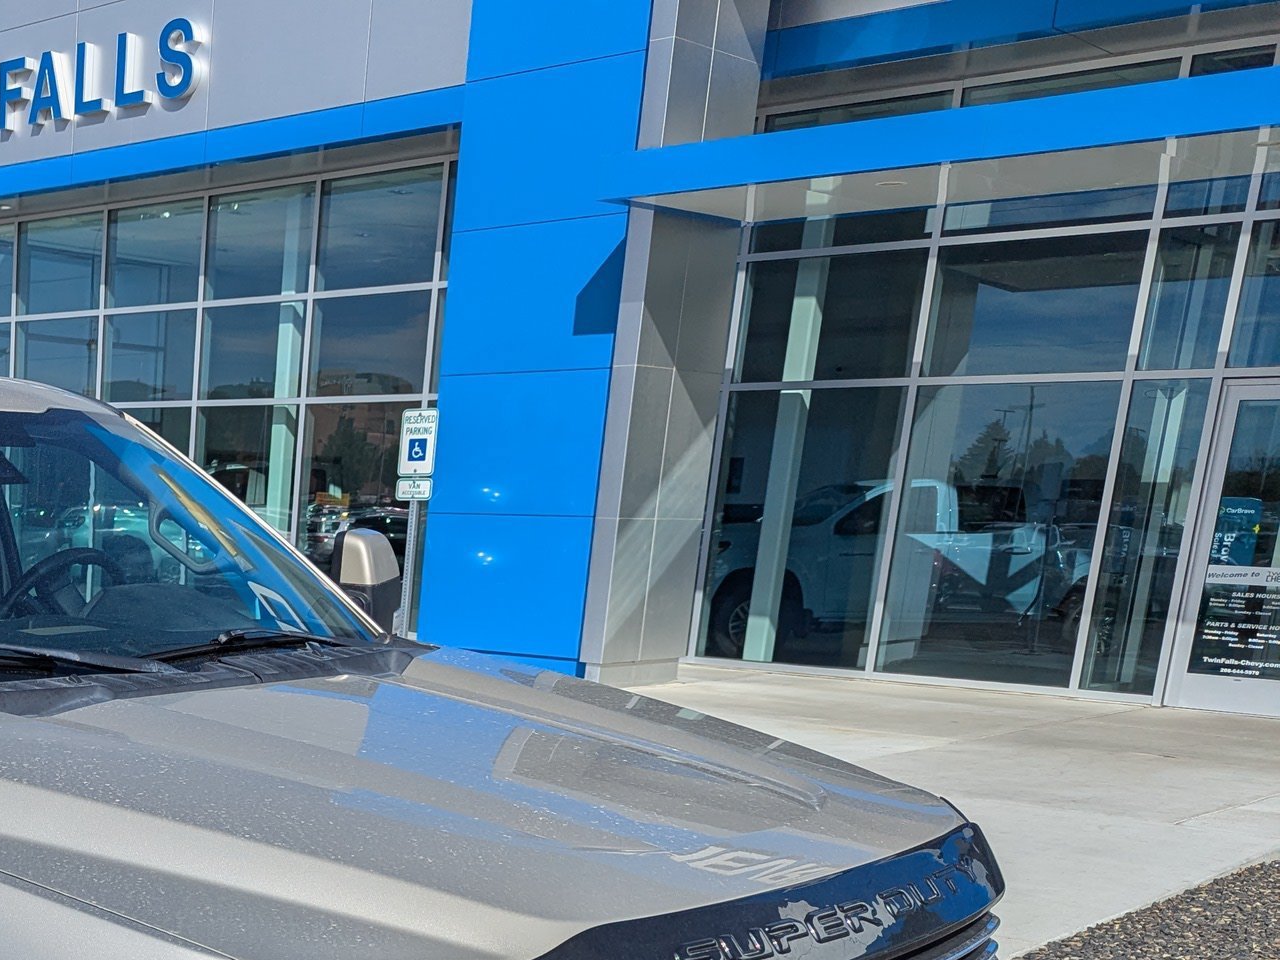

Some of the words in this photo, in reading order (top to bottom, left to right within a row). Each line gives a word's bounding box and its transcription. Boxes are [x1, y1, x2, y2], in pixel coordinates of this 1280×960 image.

[405, 415, 435, 424] RESERVED
[406, 427, 432, 435] PARKING
[878, 856, 979, 916] DUTY
